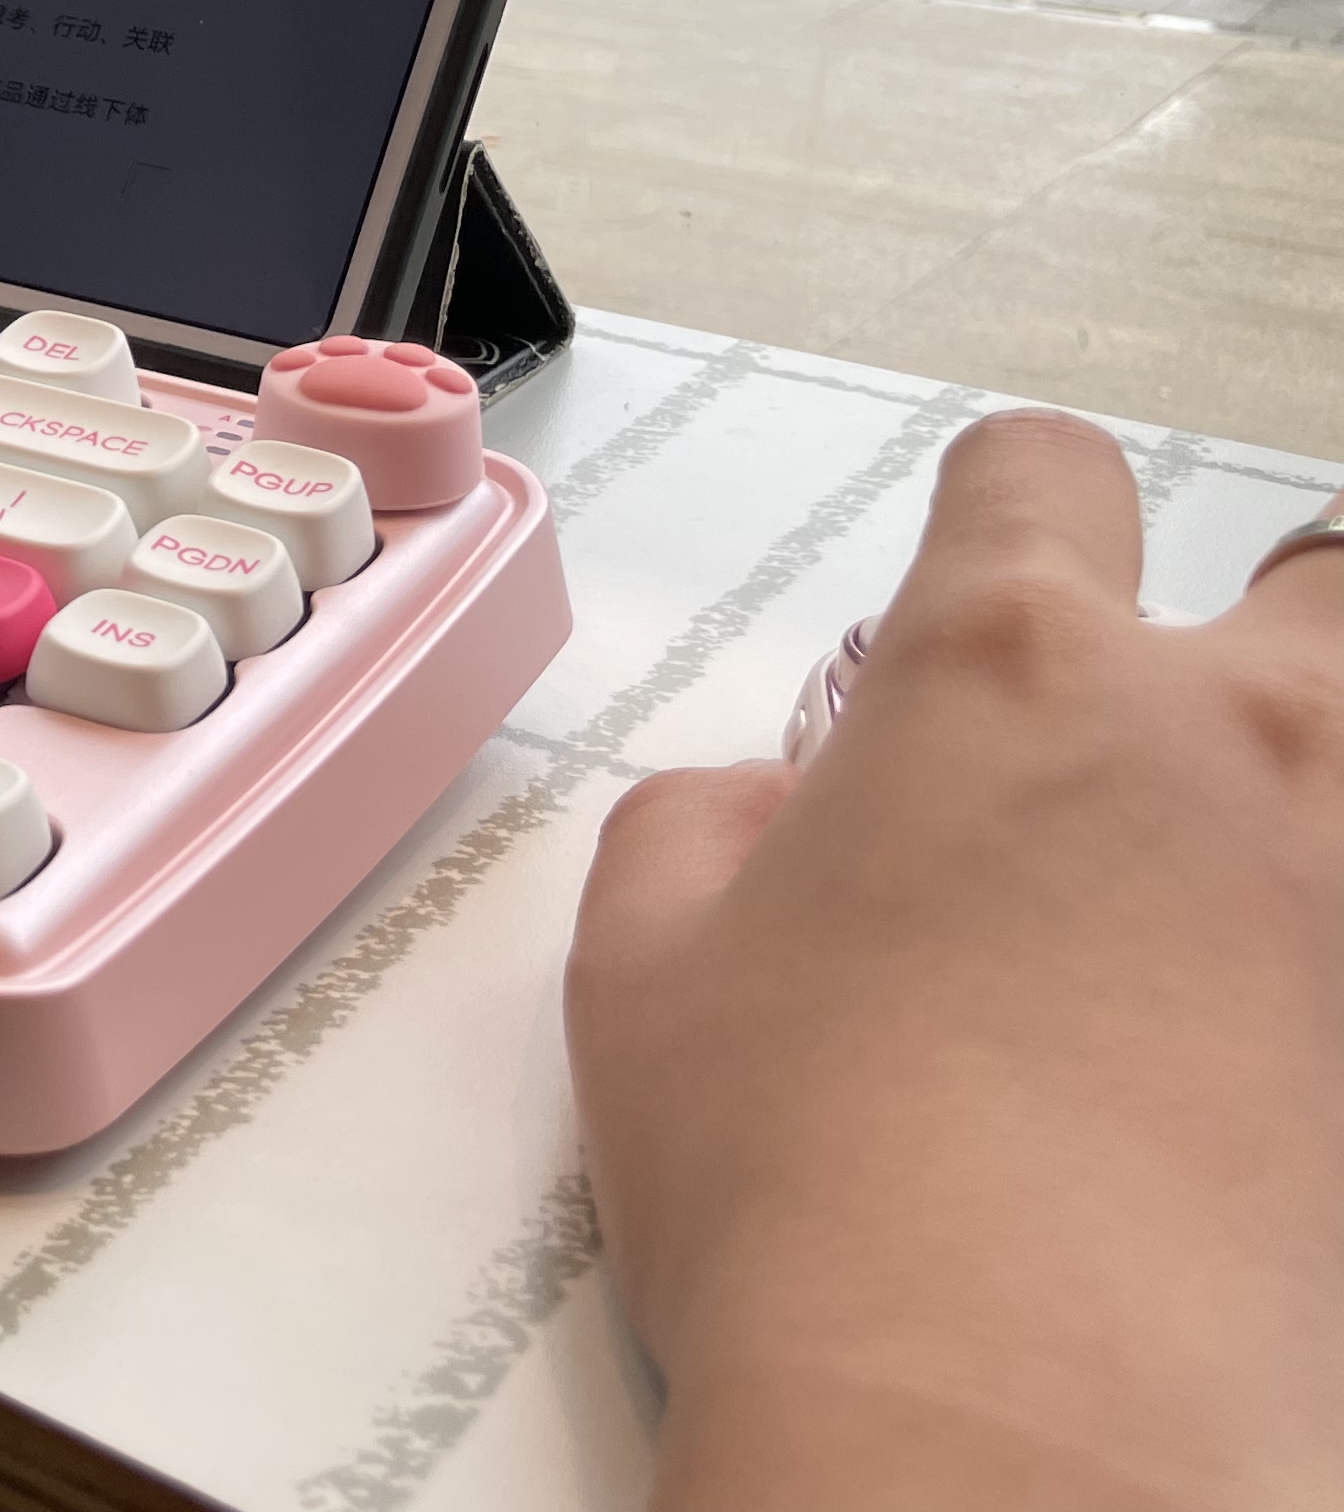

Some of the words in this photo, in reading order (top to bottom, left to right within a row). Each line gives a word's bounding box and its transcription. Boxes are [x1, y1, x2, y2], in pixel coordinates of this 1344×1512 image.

[22, 334, 81, 361] DEL
[229, 460, 334, 498] PGUP
[150, 534, 261, 575] PGDN
[91, 619, 156, 648] INS
